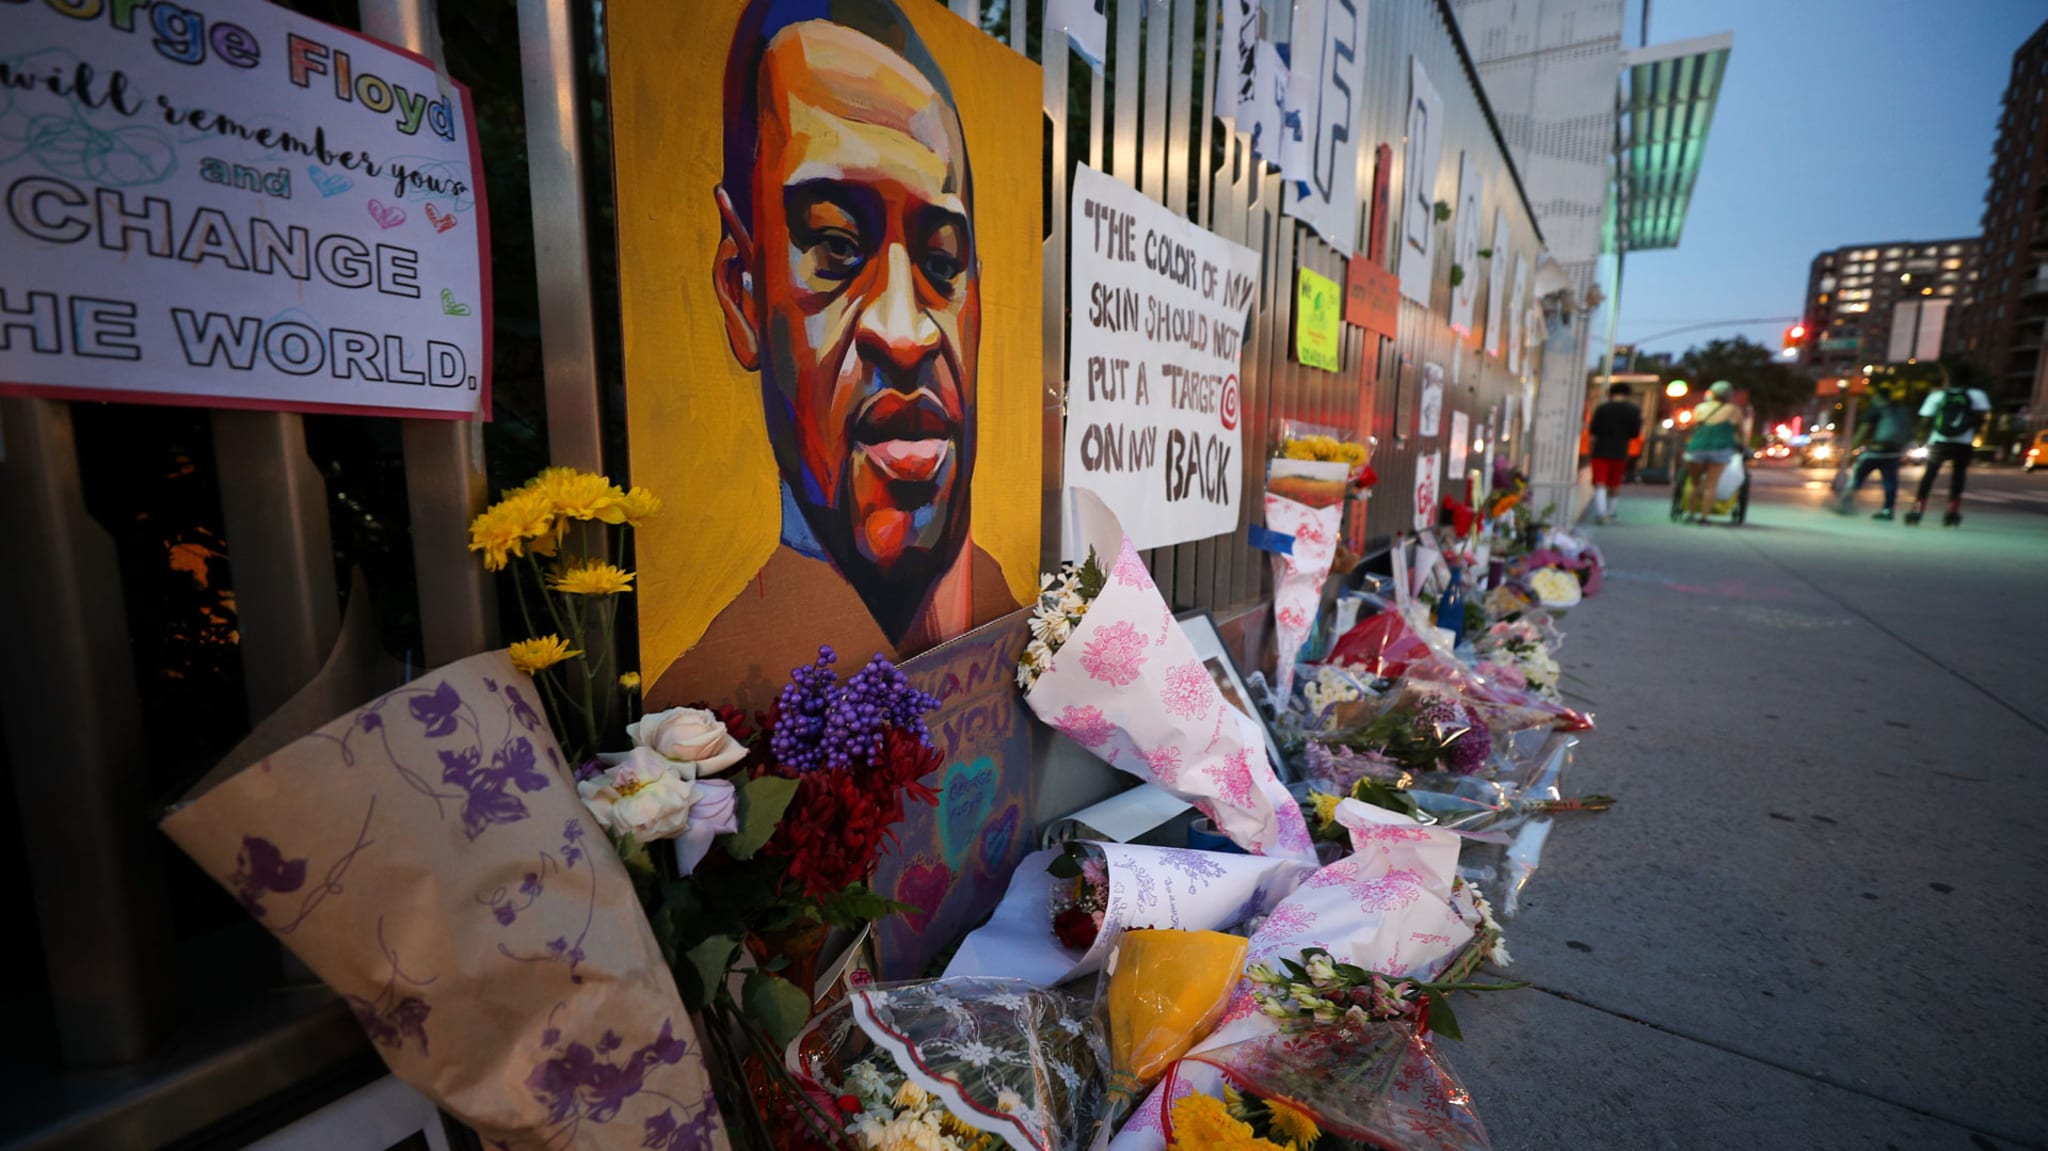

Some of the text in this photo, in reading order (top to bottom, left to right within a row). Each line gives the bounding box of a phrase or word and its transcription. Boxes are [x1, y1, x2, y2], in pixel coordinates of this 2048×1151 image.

[0, 61, 143, 117] will
[156, 93, 385, 178] remember
[287, 32, 455, 142] Floyd
[200, 156, 292, 199] and
[7, 174, 421, 300] CHANGE
[1084, 198, 1254, 312] THE COLOR OF MY
[170, 307, 477, 391] WORLD.
[1089, 281, 1139, 333] SKIN
[1145, 294, 1208, 352] SHOULD
[1212, 321, 1240, 364] NOT
[1088, 356, 1223, 414] PUT A TARGET
[1080, 422, 1231, 507] ON MY BACK
[943, 700, 1011, 758] YOU
